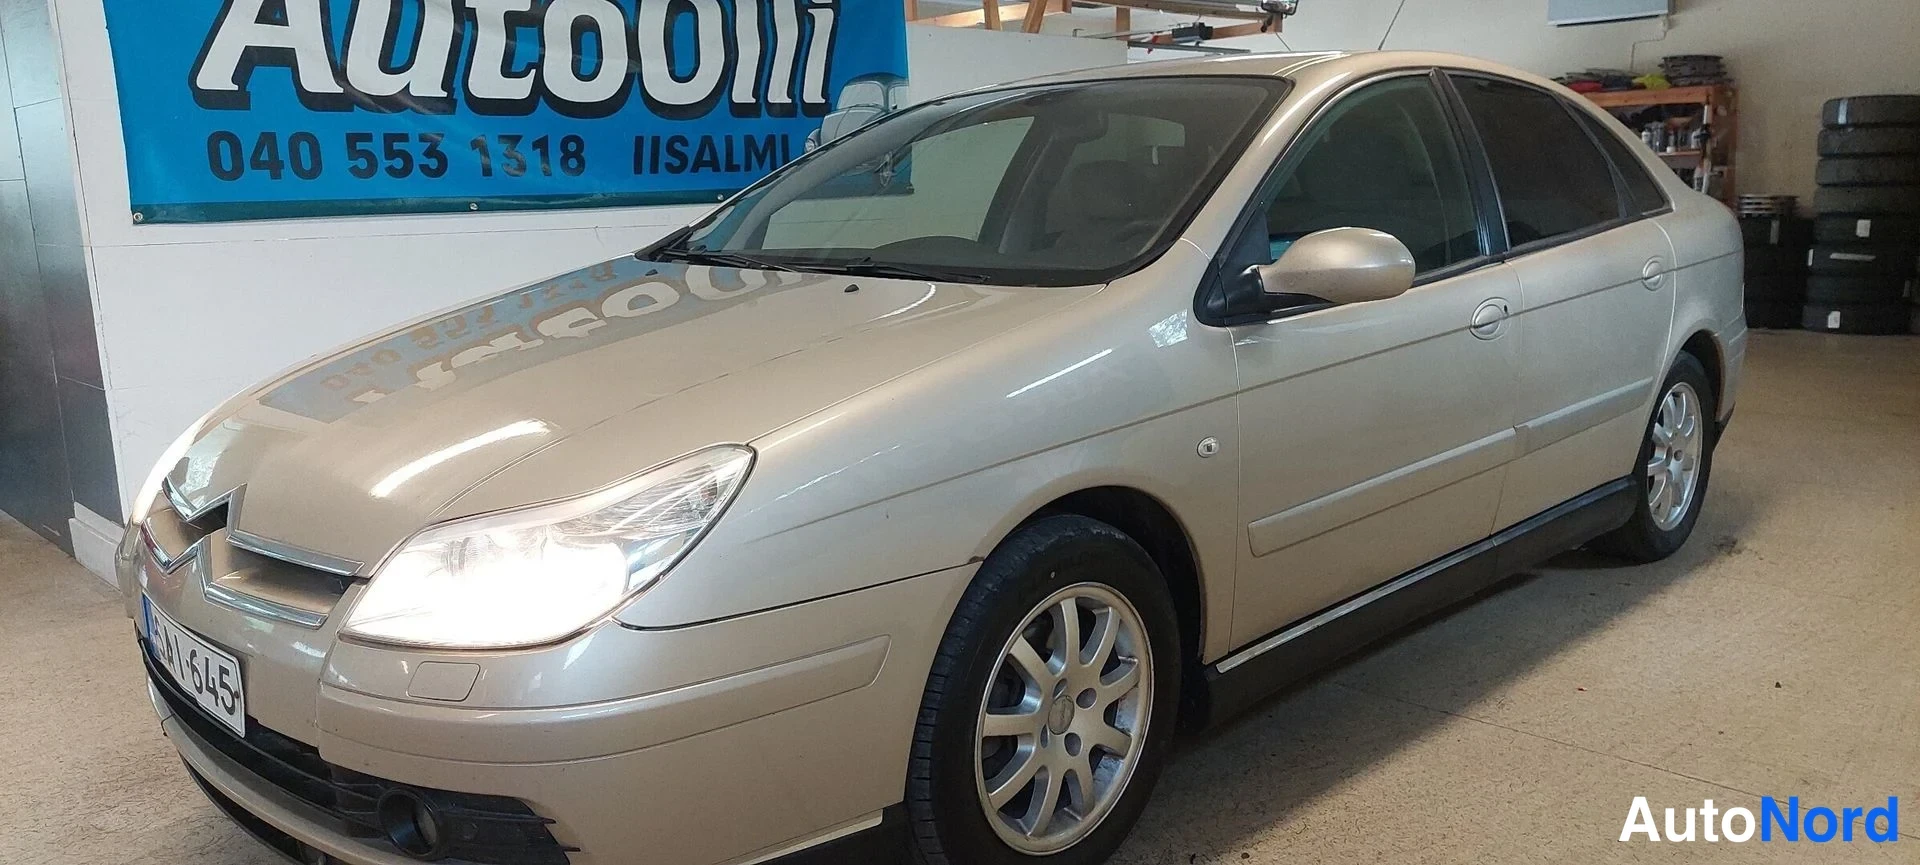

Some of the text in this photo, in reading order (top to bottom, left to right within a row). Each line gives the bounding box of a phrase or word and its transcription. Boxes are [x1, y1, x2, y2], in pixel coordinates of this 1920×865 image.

[207, 130, 791, 181] 040 553 1318 IISALMI
